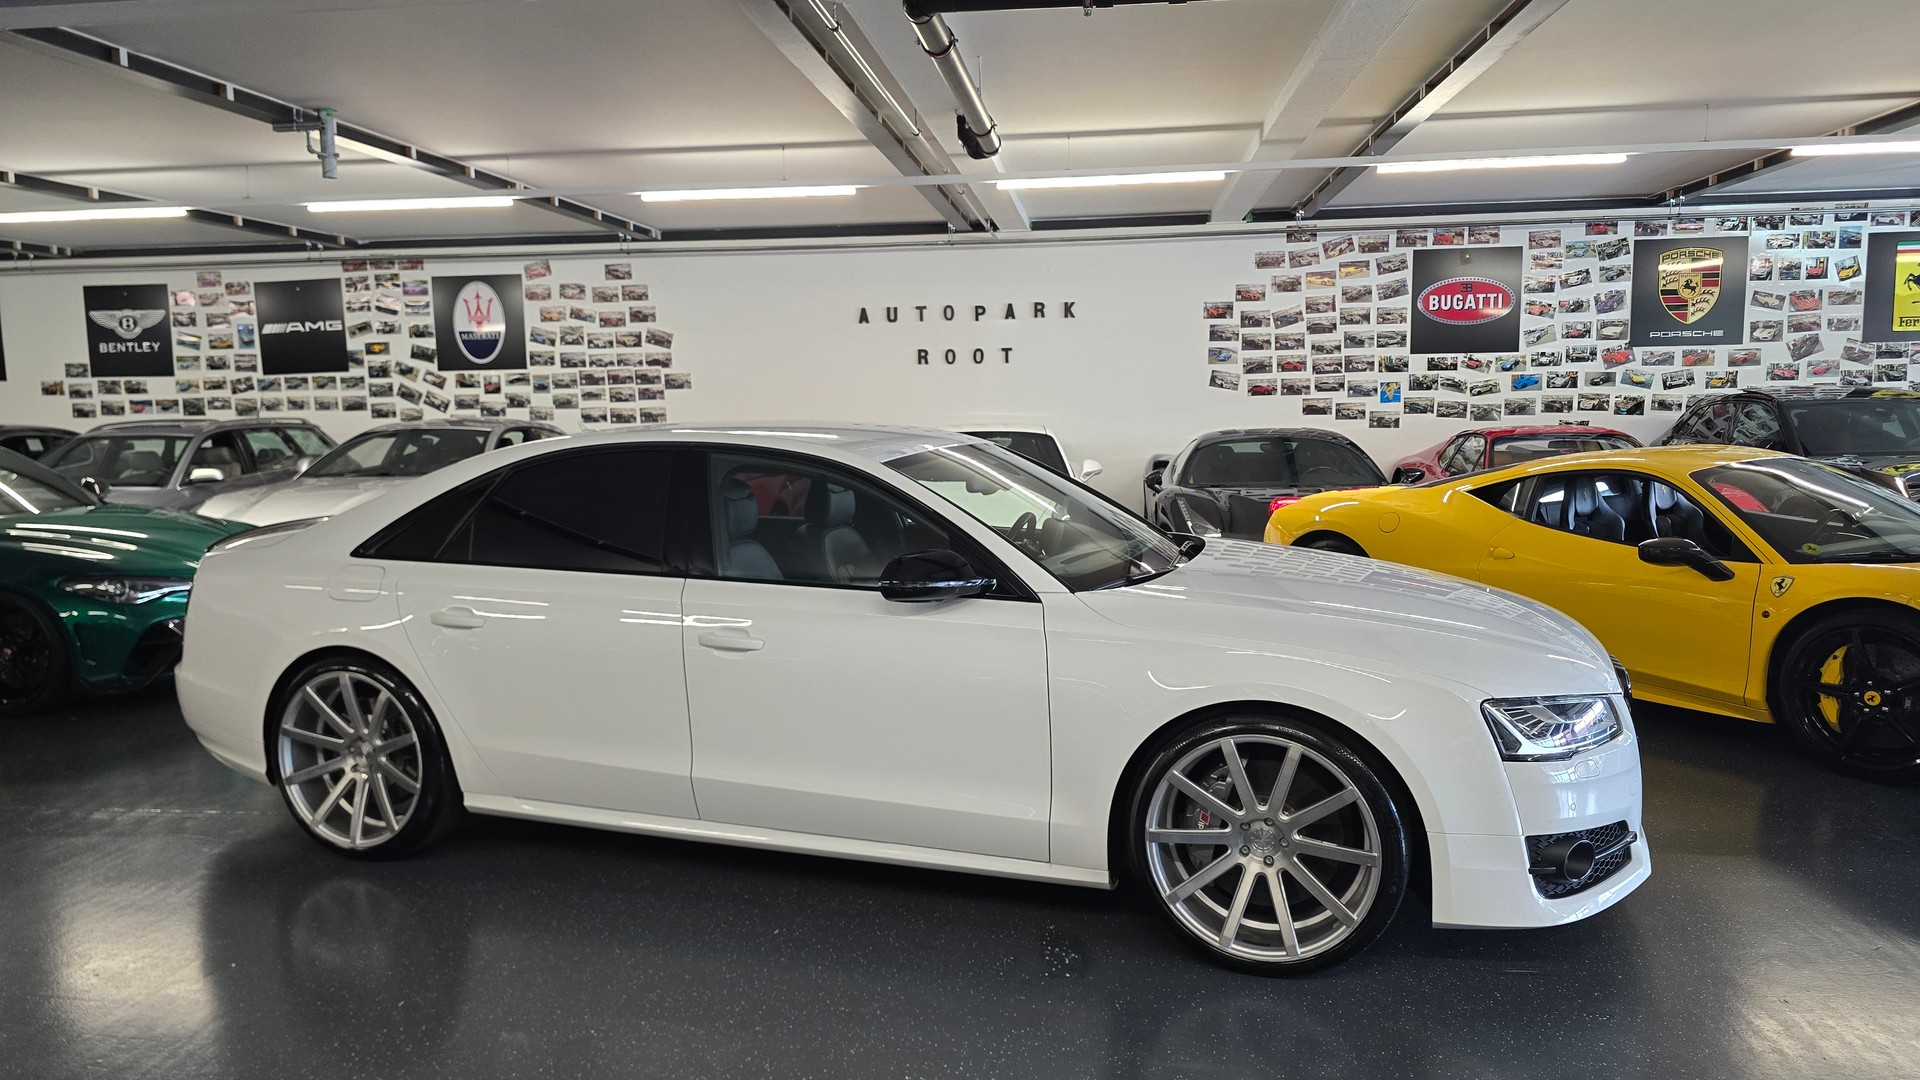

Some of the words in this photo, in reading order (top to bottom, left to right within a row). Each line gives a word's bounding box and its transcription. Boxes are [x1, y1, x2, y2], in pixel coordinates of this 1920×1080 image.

[1662, 250, 1719, 262] PORSCHE
[1429, 293, 1503, 311] BUGATTI
[858, 301, 1076, 324] AUTOPARK
[286, 320, 343, 333] AMG
[1898, 316, 1920, 327] Fer
[1649, 329, 1724, 338] PORSCHE
[99, 341, 160, 353] BENTLEY
[917, 347, 1013, 365] ROOT
